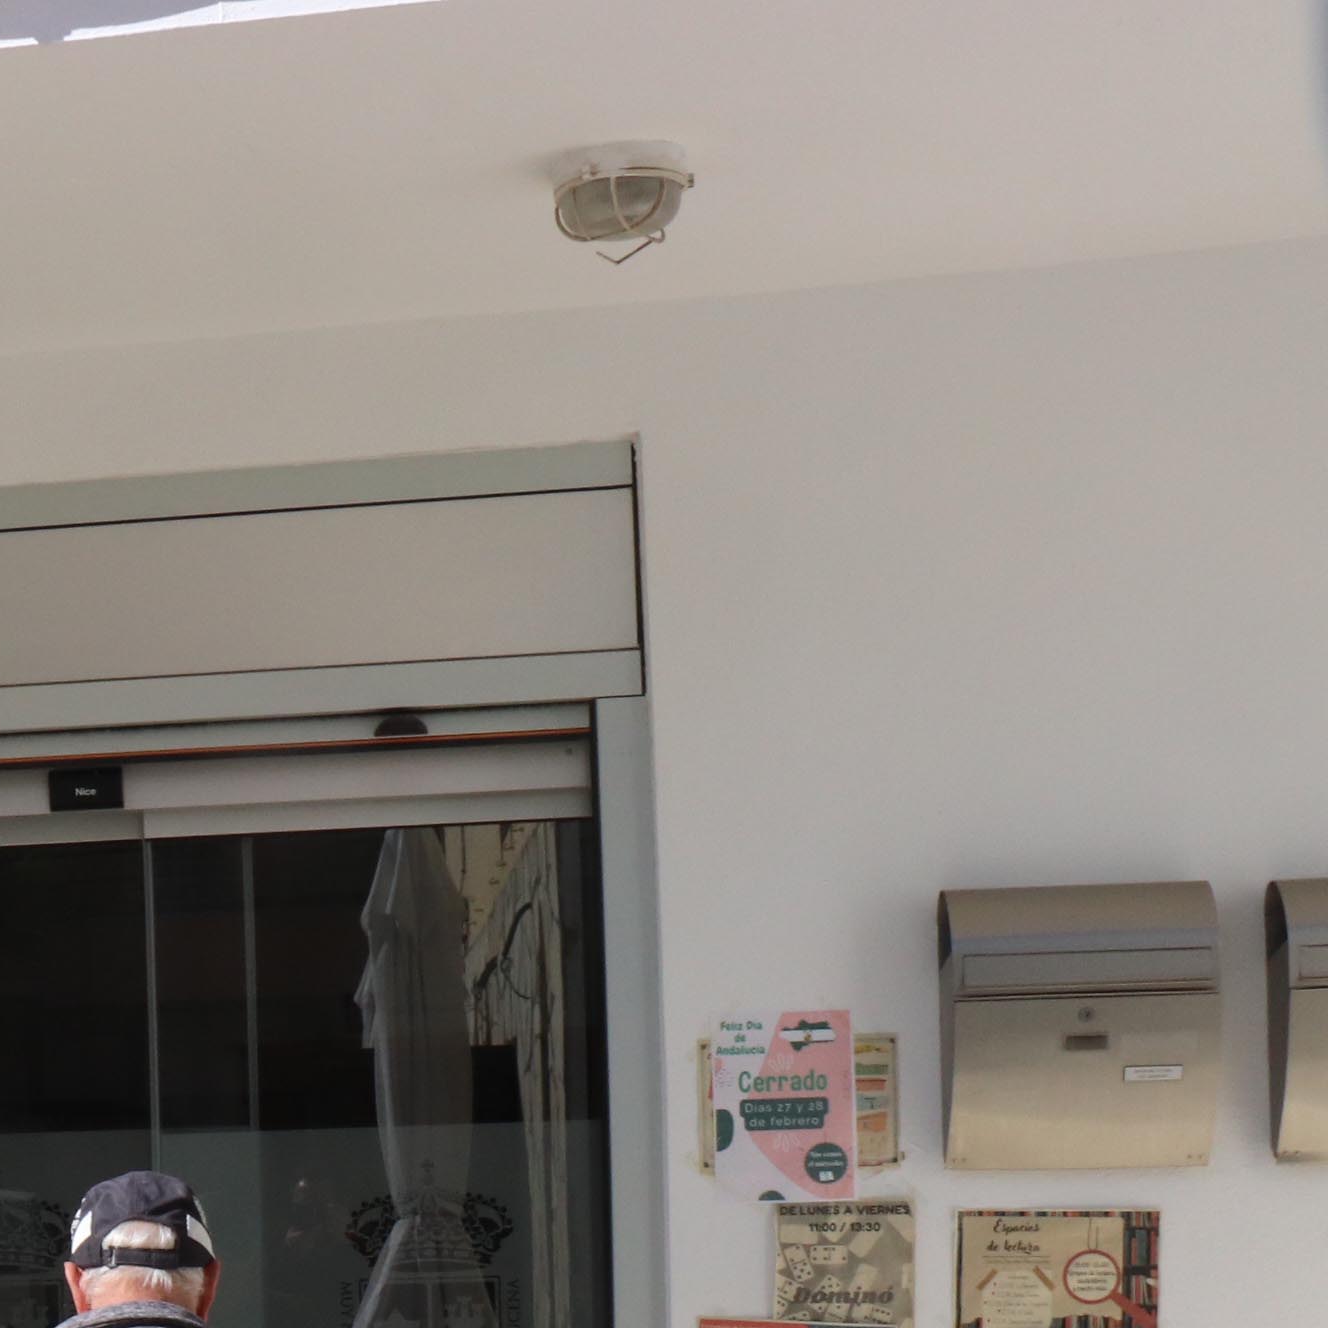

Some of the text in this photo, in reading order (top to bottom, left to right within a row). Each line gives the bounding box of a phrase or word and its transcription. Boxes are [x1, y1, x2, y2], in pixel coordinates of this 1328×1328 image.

[75, 787, 96, 797] Nice
[737, 1069, 829, 1093] Cerrado
[776, 1103, 791, 1112] 27
[796, 1104, 803, 1113] y
[807, 1101, 825, 1111] 28
[748, 1115, 820, 1128] de febrero
[780, 1204, 911, 1216] DE LUNES A VIERNES
[808, 1222, 837, 1232] 11:00
[986, 1240, 999, 1251] de
